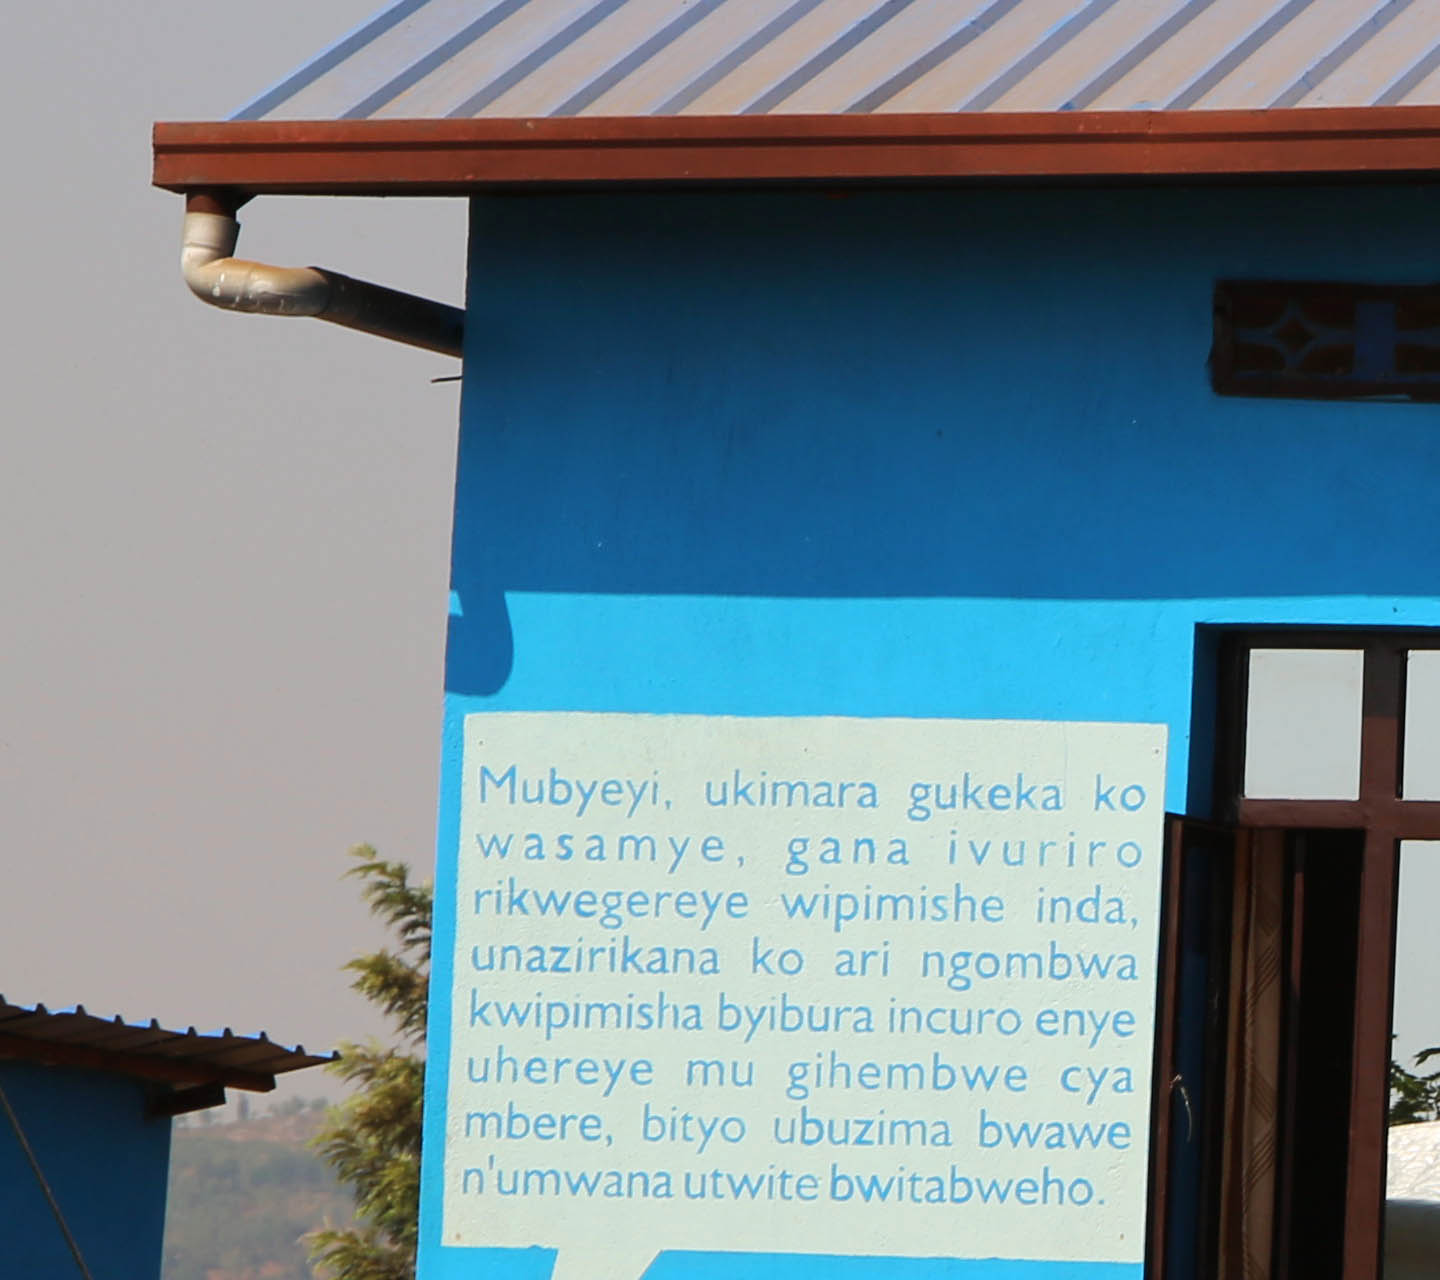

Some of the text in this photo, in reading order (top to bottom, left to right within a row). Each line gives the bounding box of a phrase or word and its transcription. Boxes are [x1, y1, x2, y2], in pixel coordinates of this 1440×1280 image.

[480, 765, 1146, 821] Mubyeyi, ukimara gukeka ko
[476, 830, 1142, 875] wasamye, gana ivuriro
[475, 877, 1137, 932] rikwegereye wipimishe inda,
[471, 936, 1138, 992] unazirikana ko ari ngombwa
[470, 988, 1135, 1048] kwipimisha byibura incuro enye
[468, 1045, 1133, 1105] uhereye mu gihembwe cya
[465, 1101, 1130, 1154] mbere, bityo ubuzima bwawe
[463, 1155, 1104, 1206] n'umwana utwite bwitabweho.
